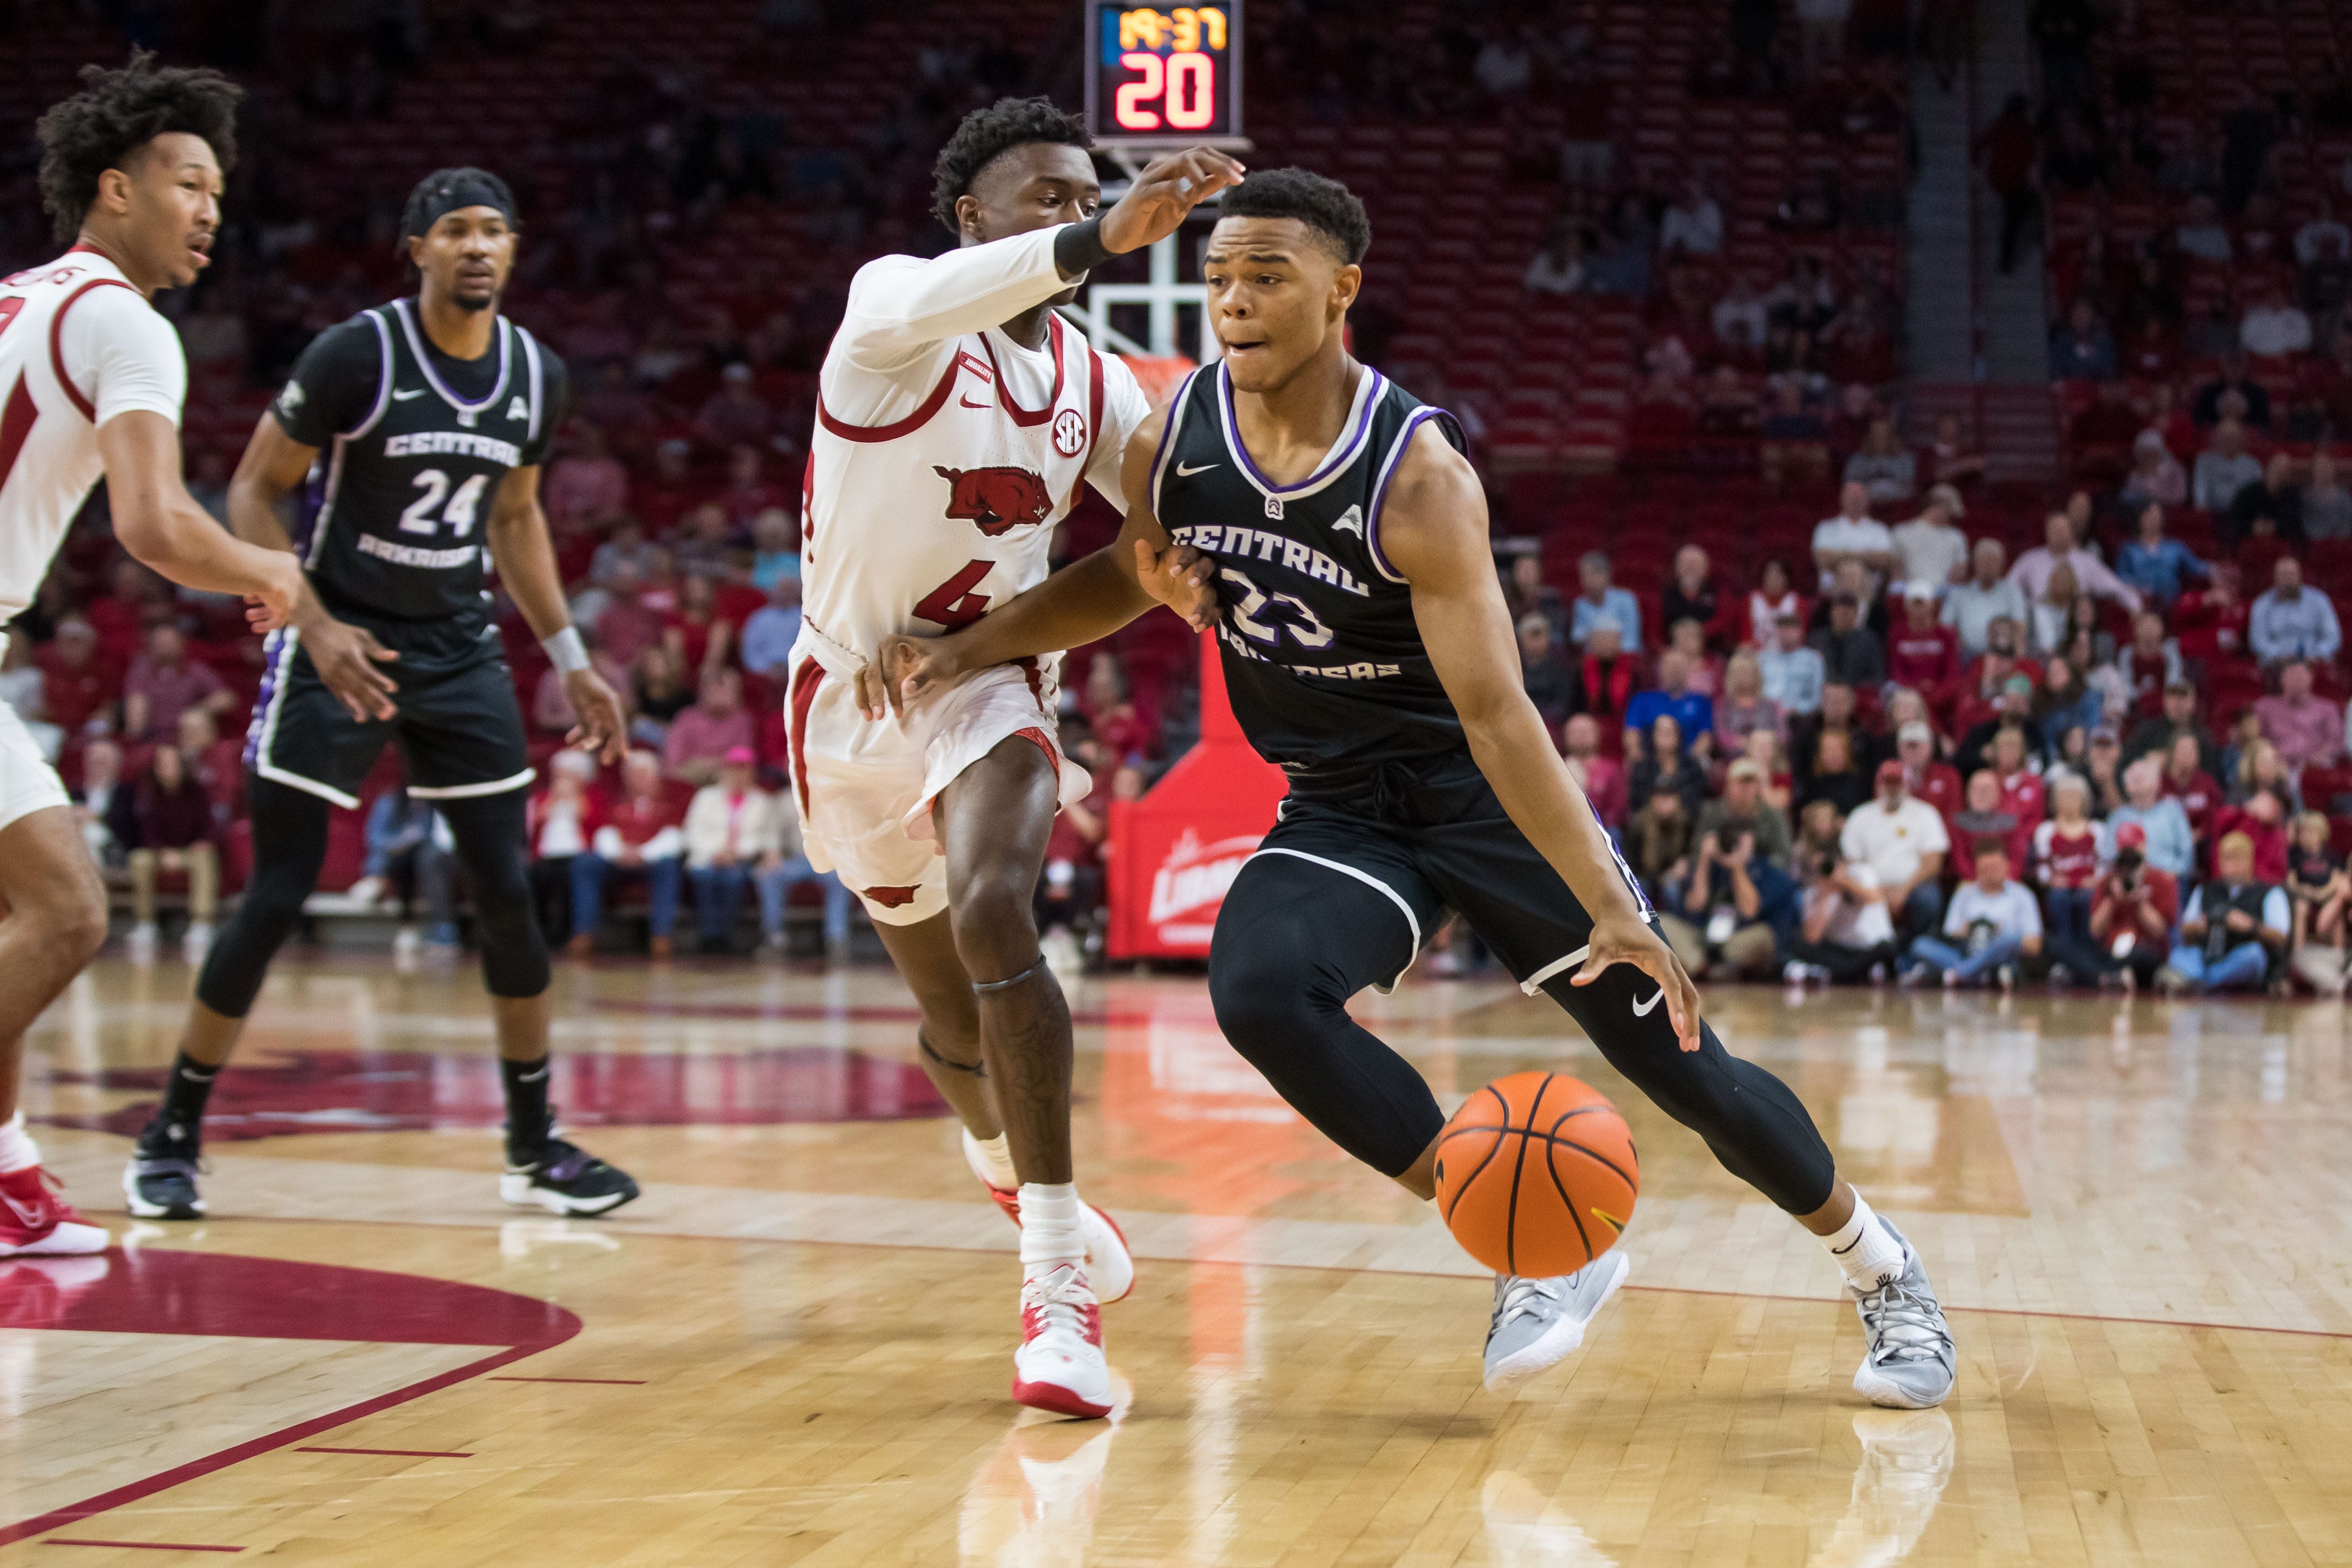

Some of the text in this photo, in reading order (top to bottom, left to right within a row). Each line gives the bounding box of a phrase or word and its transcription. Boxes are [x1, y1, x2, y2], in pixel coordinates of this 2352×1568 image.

[1116, 52, 1214, 130] 20
[965, 358, 992, 379] EQUALITY
[384, 431, 522, 468] CENTRAL
[1055, 411, 1084, 454] SEC
[399, 469, 490, 537] 24
[1171, 525, 1370, 598] CENTRAL
[911, 559, 997, 636] 4
[1221, 567, 1335, 651] 23
